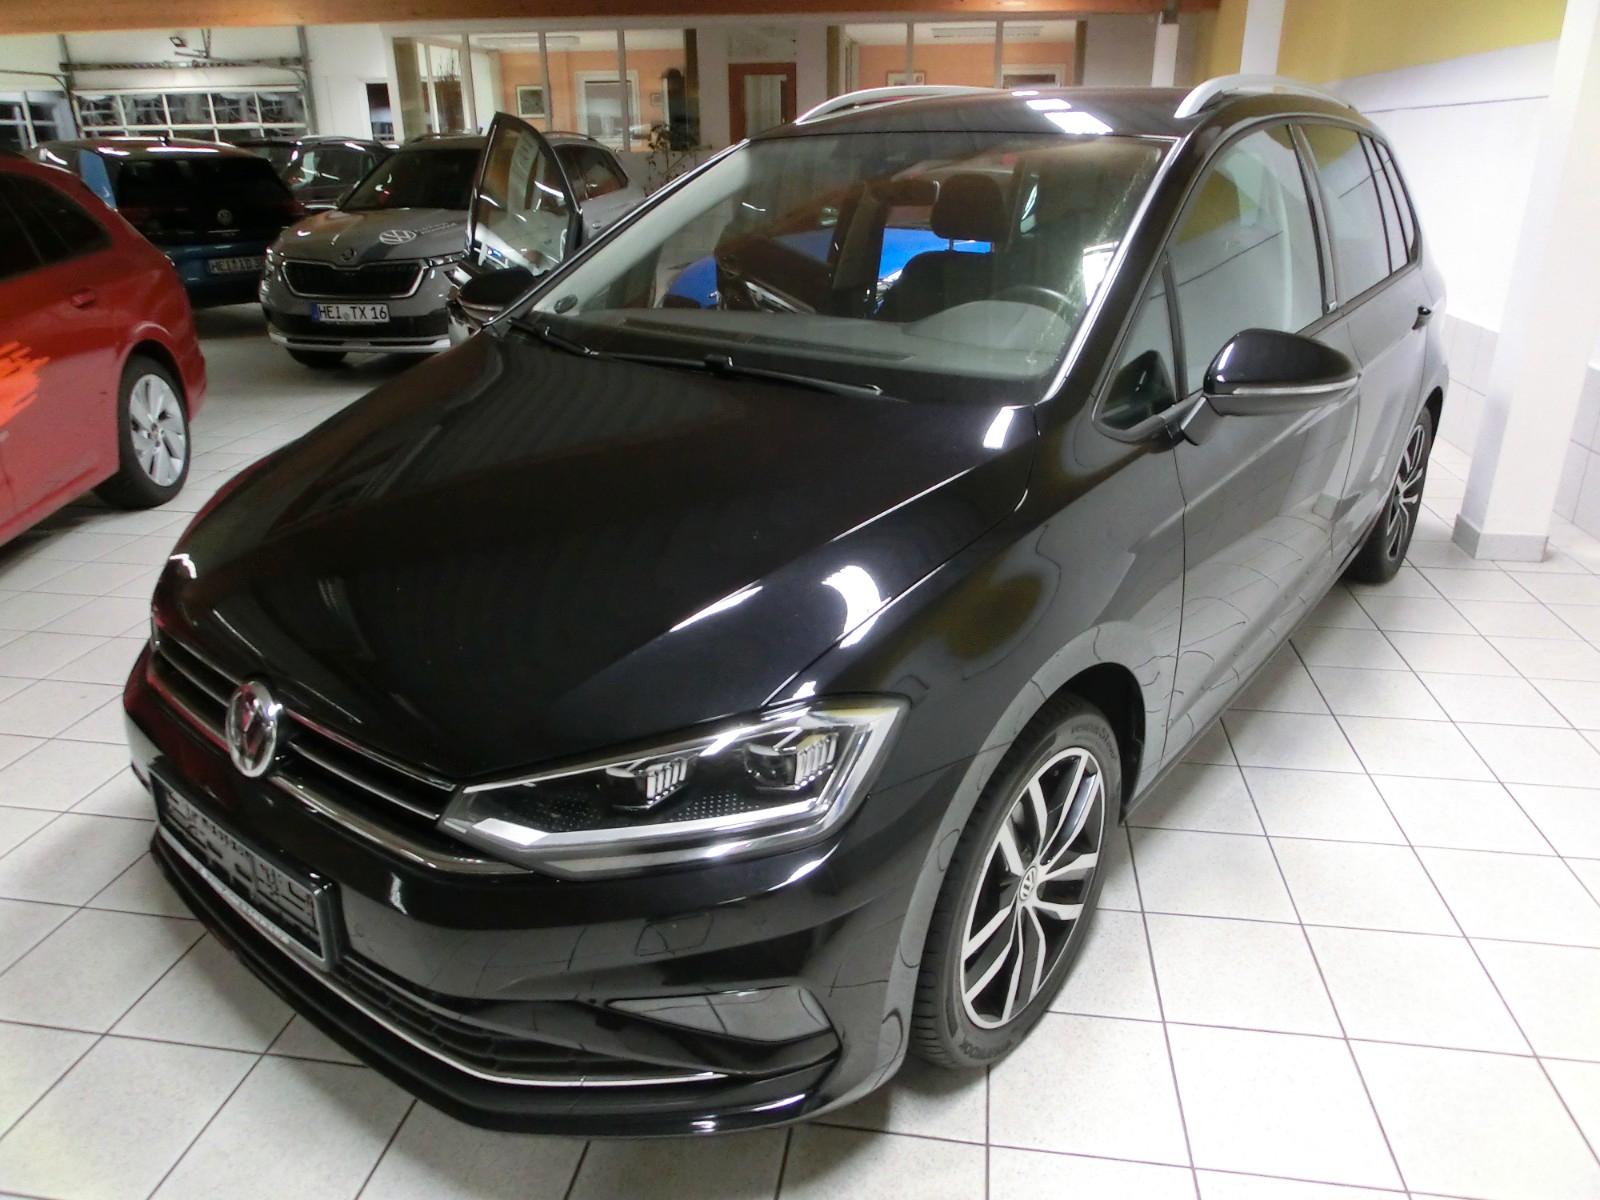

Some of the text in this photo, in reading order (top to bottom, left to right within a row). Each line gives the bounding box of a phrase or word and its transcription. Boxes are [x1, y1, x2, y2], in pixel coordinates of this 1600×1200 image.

[319, 305, 387, 320] HEI TX 16
